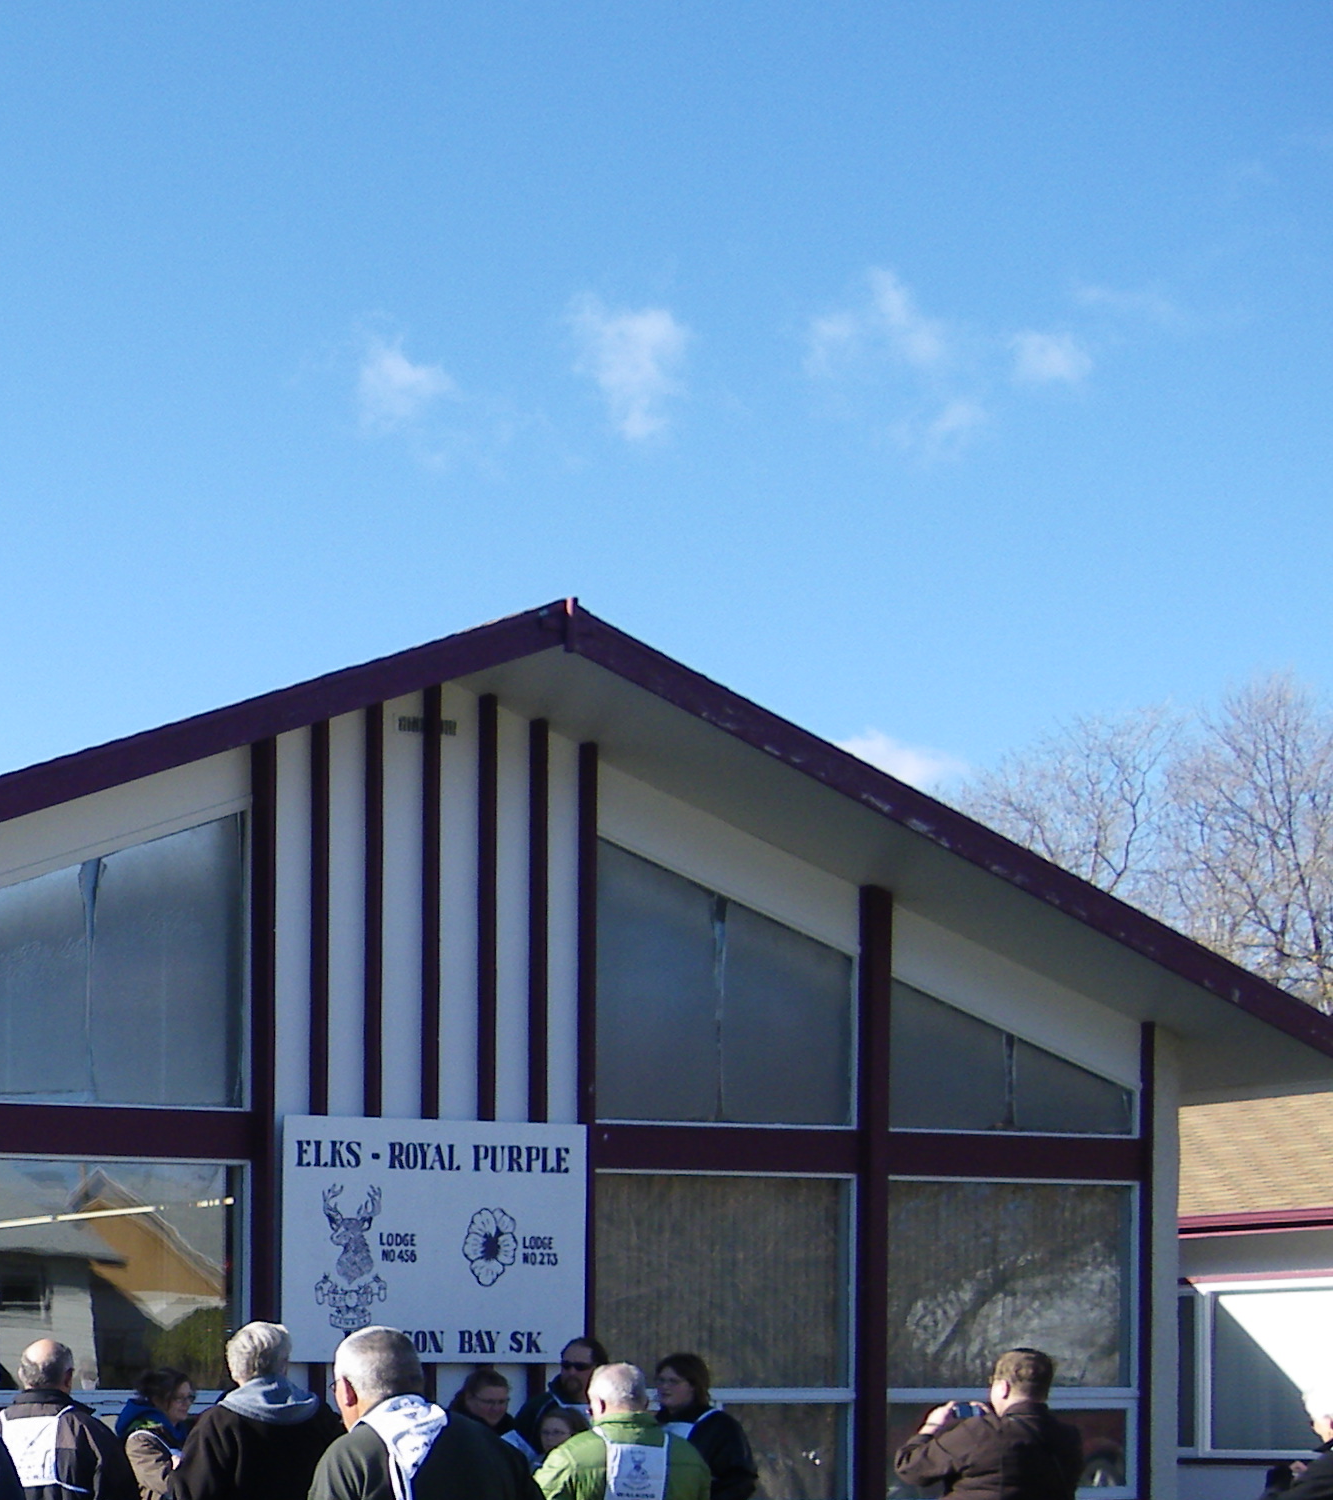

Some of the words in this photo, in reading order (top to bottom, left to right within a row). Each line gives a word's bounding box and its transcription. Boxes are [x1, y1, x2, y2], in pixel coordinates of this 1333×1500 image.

[295, 1140, 362, 1168] ELKS
[388, 1141, 461, 1171] ROYAL
[472, 1144, 570, 1174] PURPLE
[379, 1232, 417, 1247] LODGE
[522, 1236, 554, 1250] LODGE
